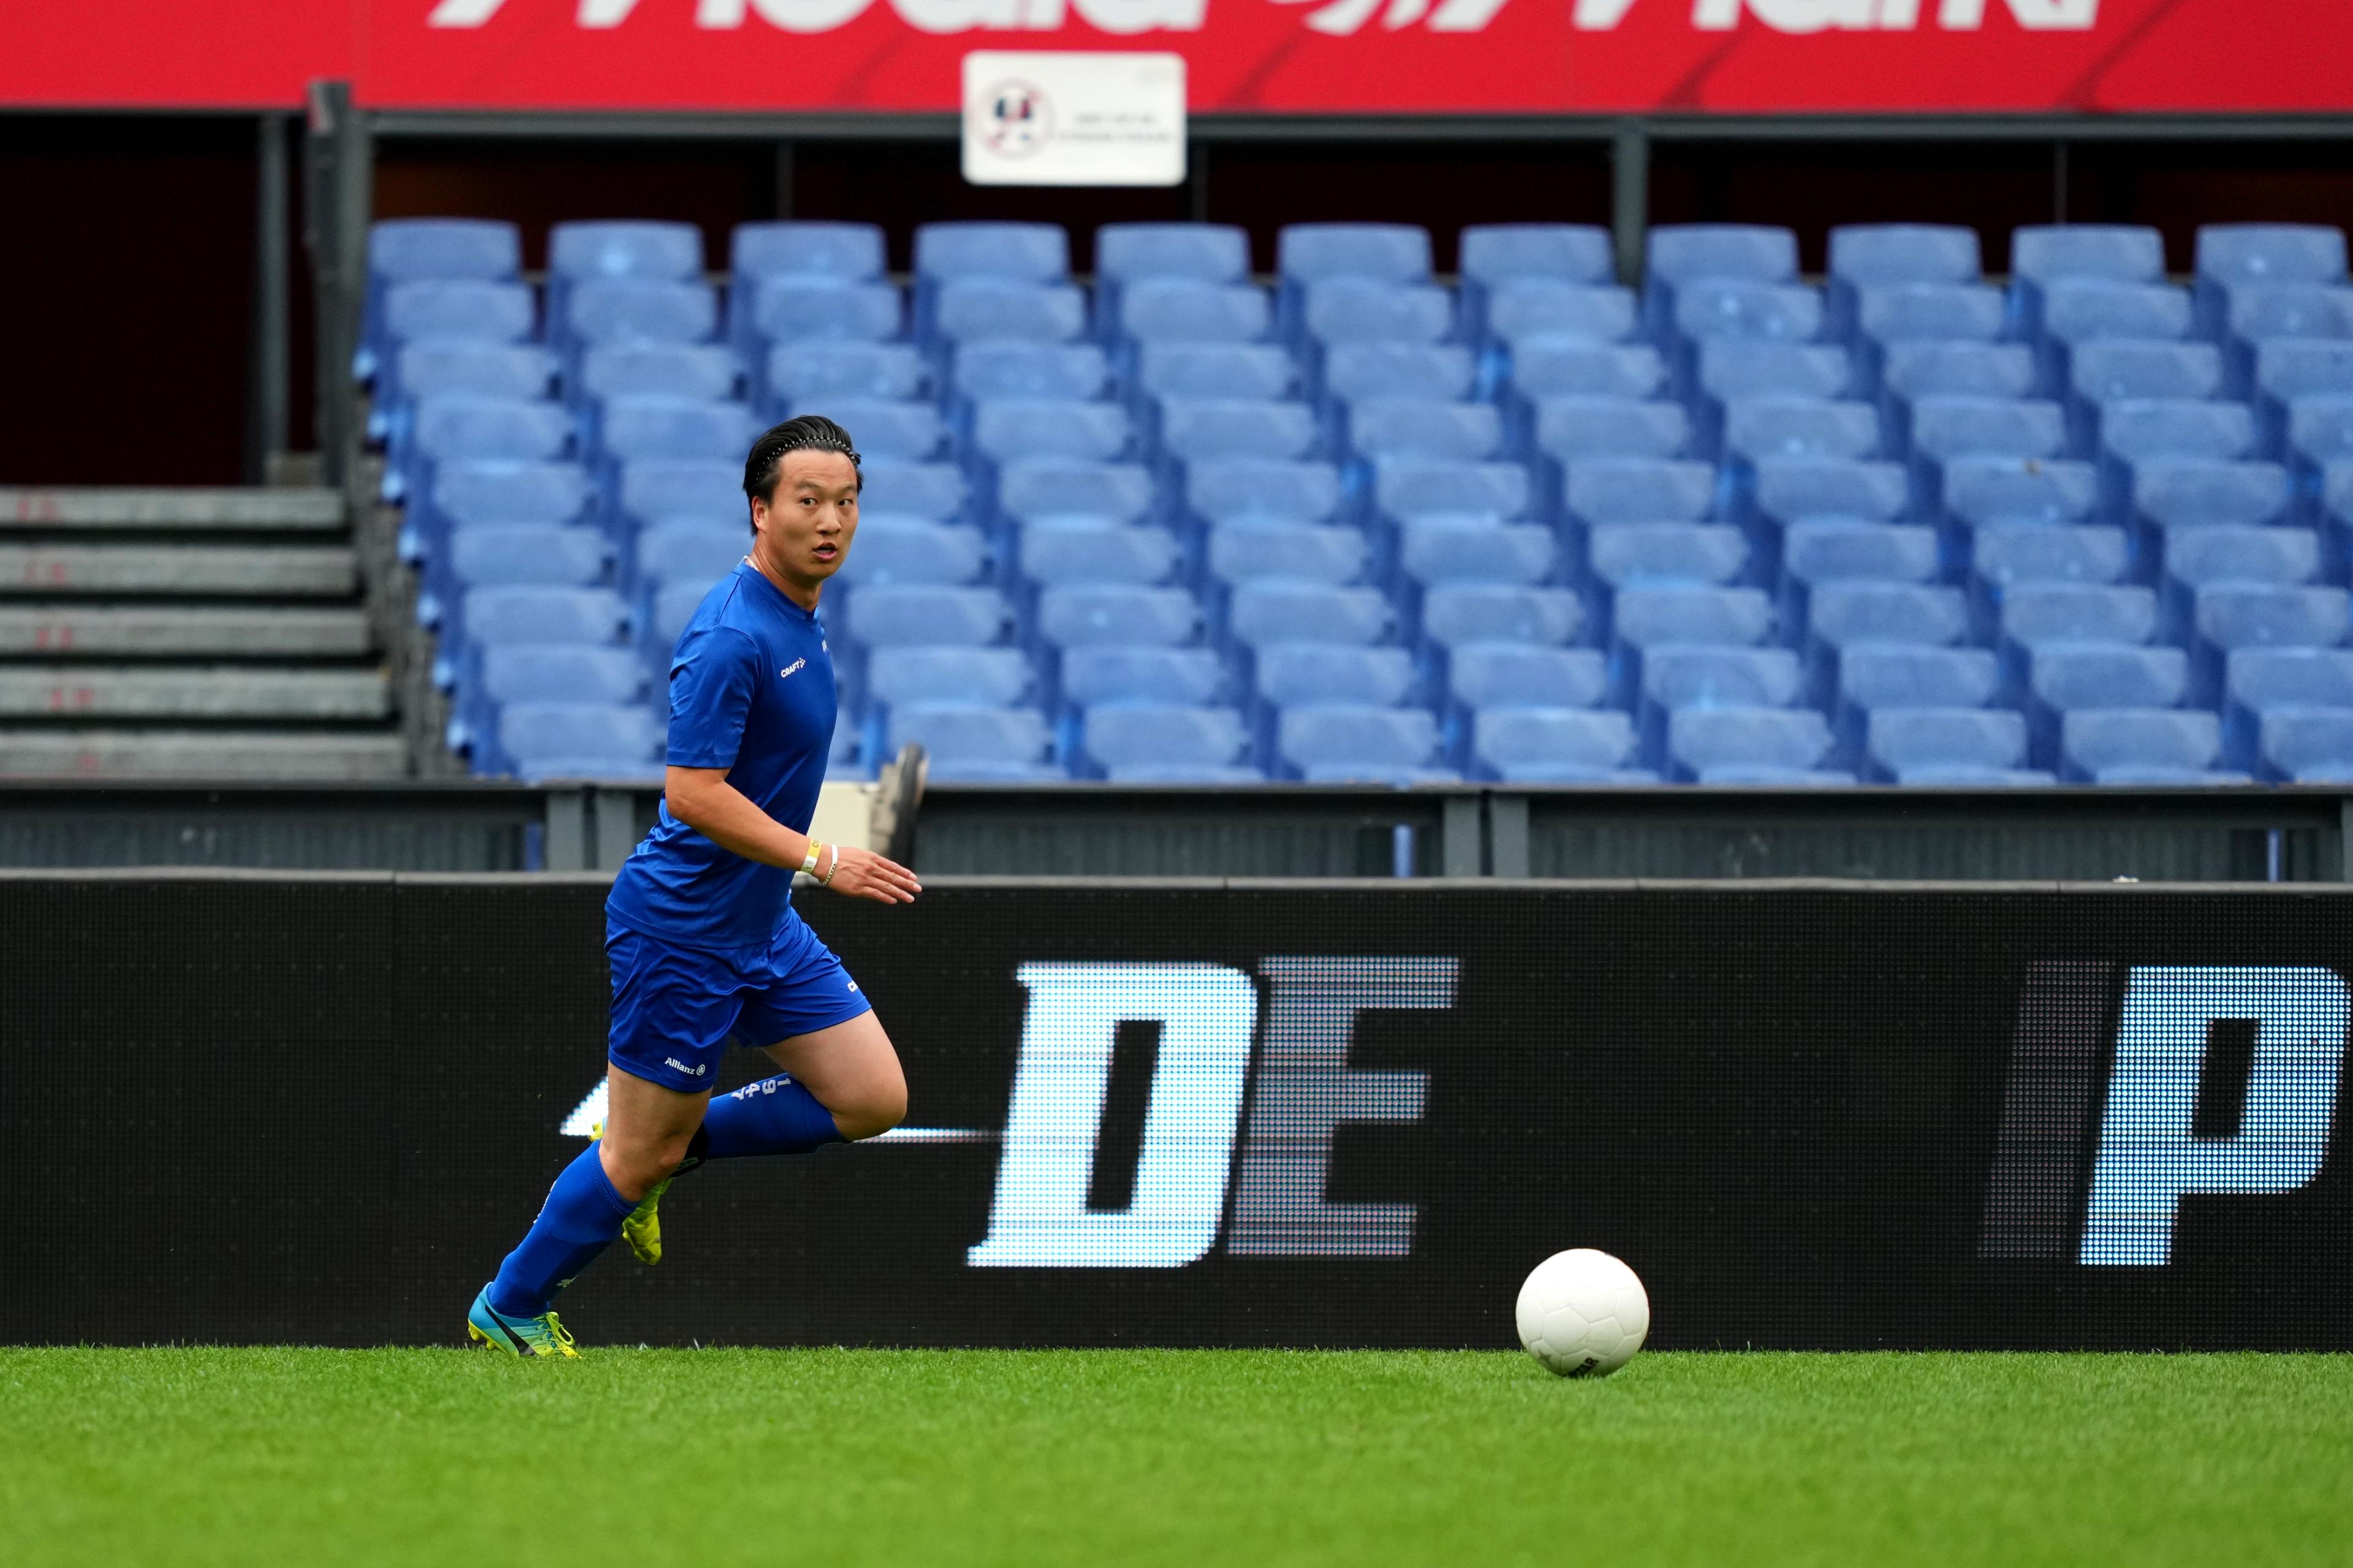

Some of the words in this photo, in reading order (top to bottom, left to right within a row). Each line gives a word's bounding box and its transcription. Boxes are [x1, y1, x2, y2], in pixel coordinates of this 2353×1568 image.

[781, 661, 800, 678] CRAFT
[665, 1057, 695, 1075] Allianz
[967, 956, 1460, 1267] DE
